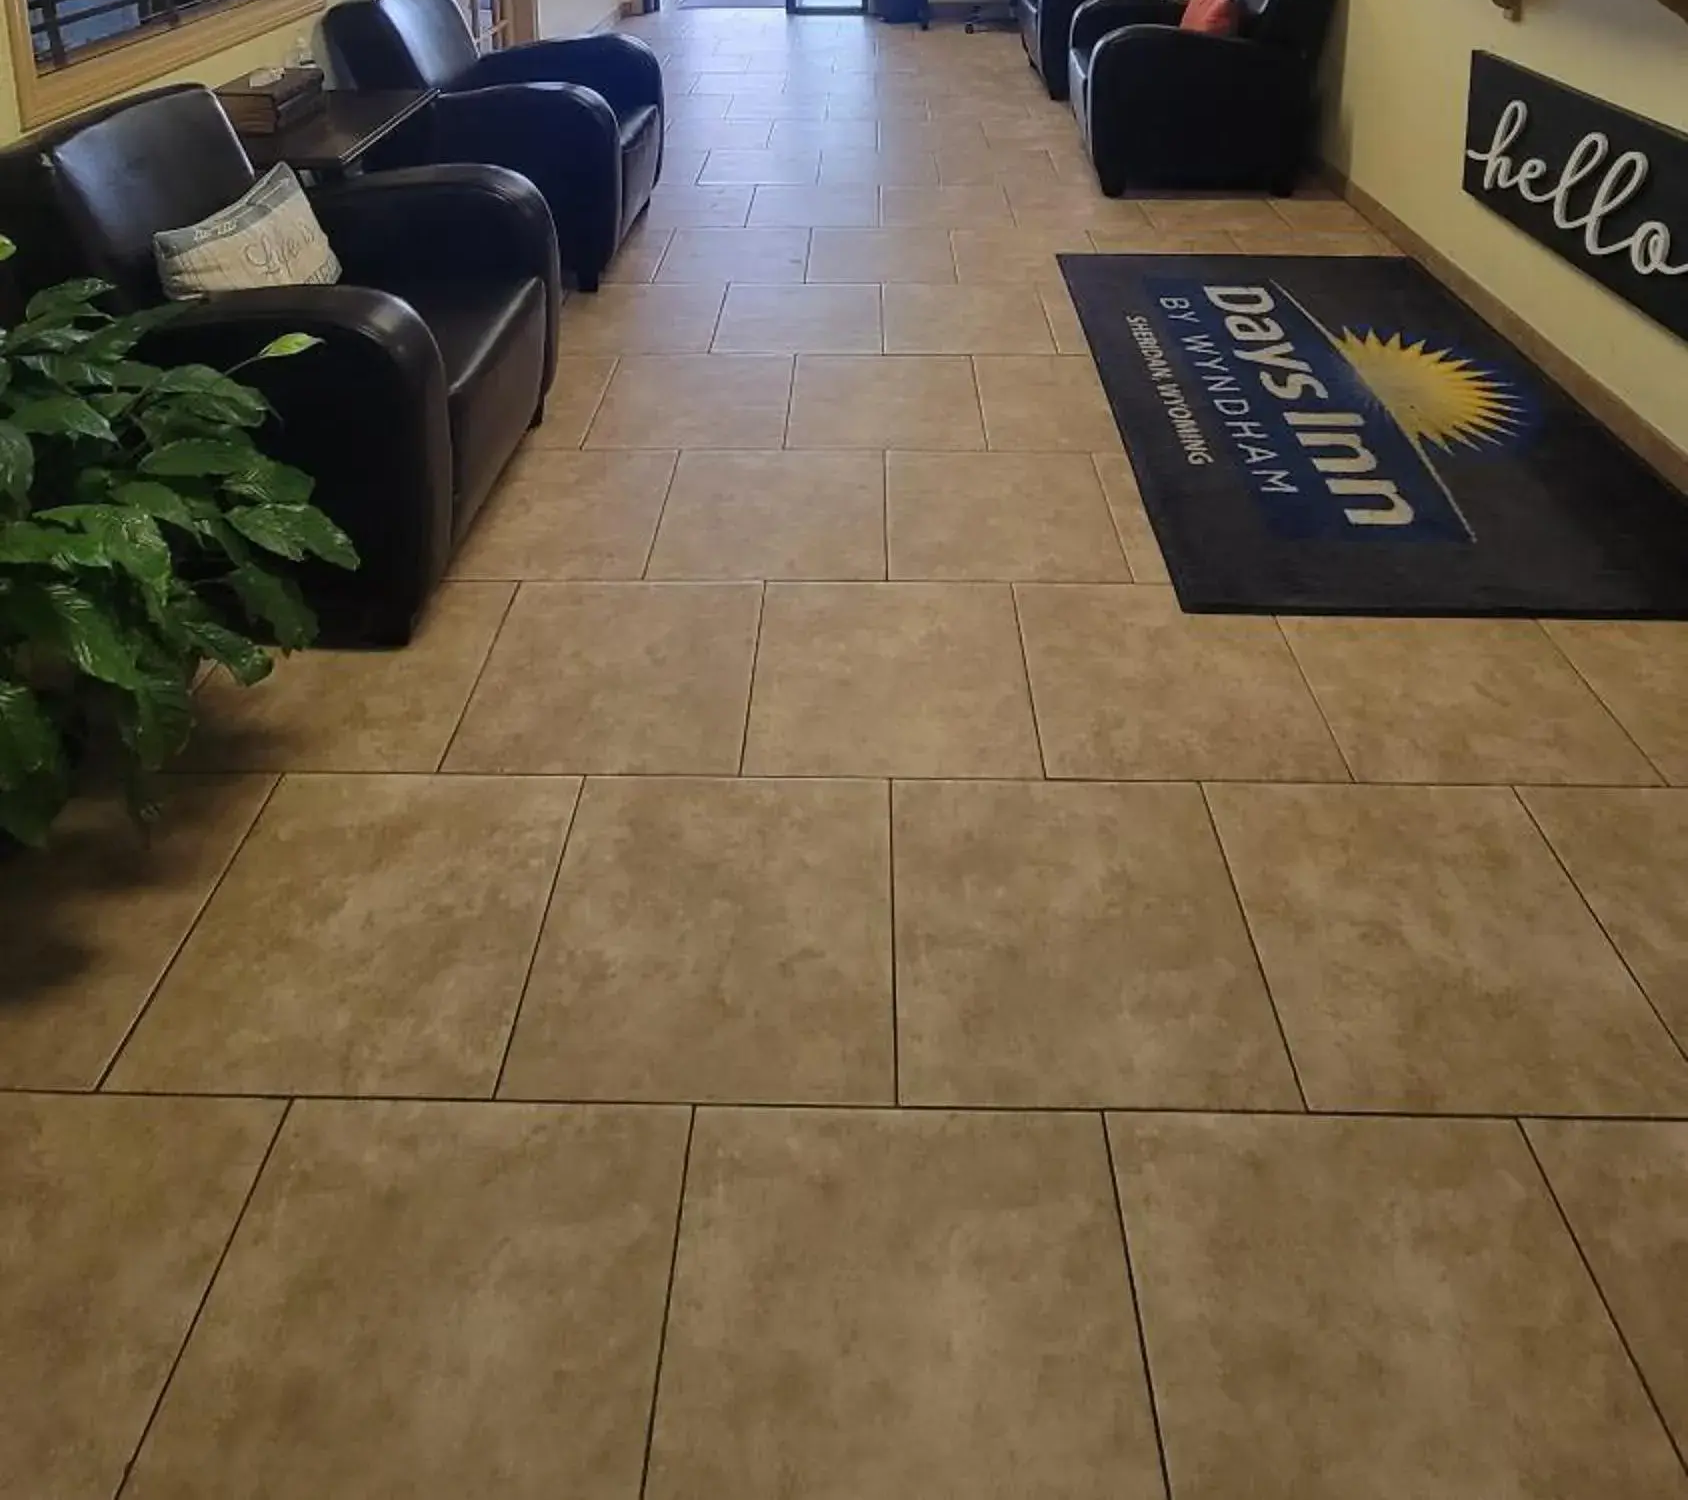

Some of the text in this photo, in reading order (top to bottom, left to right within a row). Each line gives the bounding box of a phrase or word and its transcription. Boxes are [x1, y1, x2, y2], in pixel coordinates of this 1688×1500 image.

[1467, 99, 1688, 275] hello
[1157, 384, 1214, 465] WYOMING
[1159, 297, 1299, 493] BY WYNDHAM
[1203, 286, 1414, 525] Days Inn
